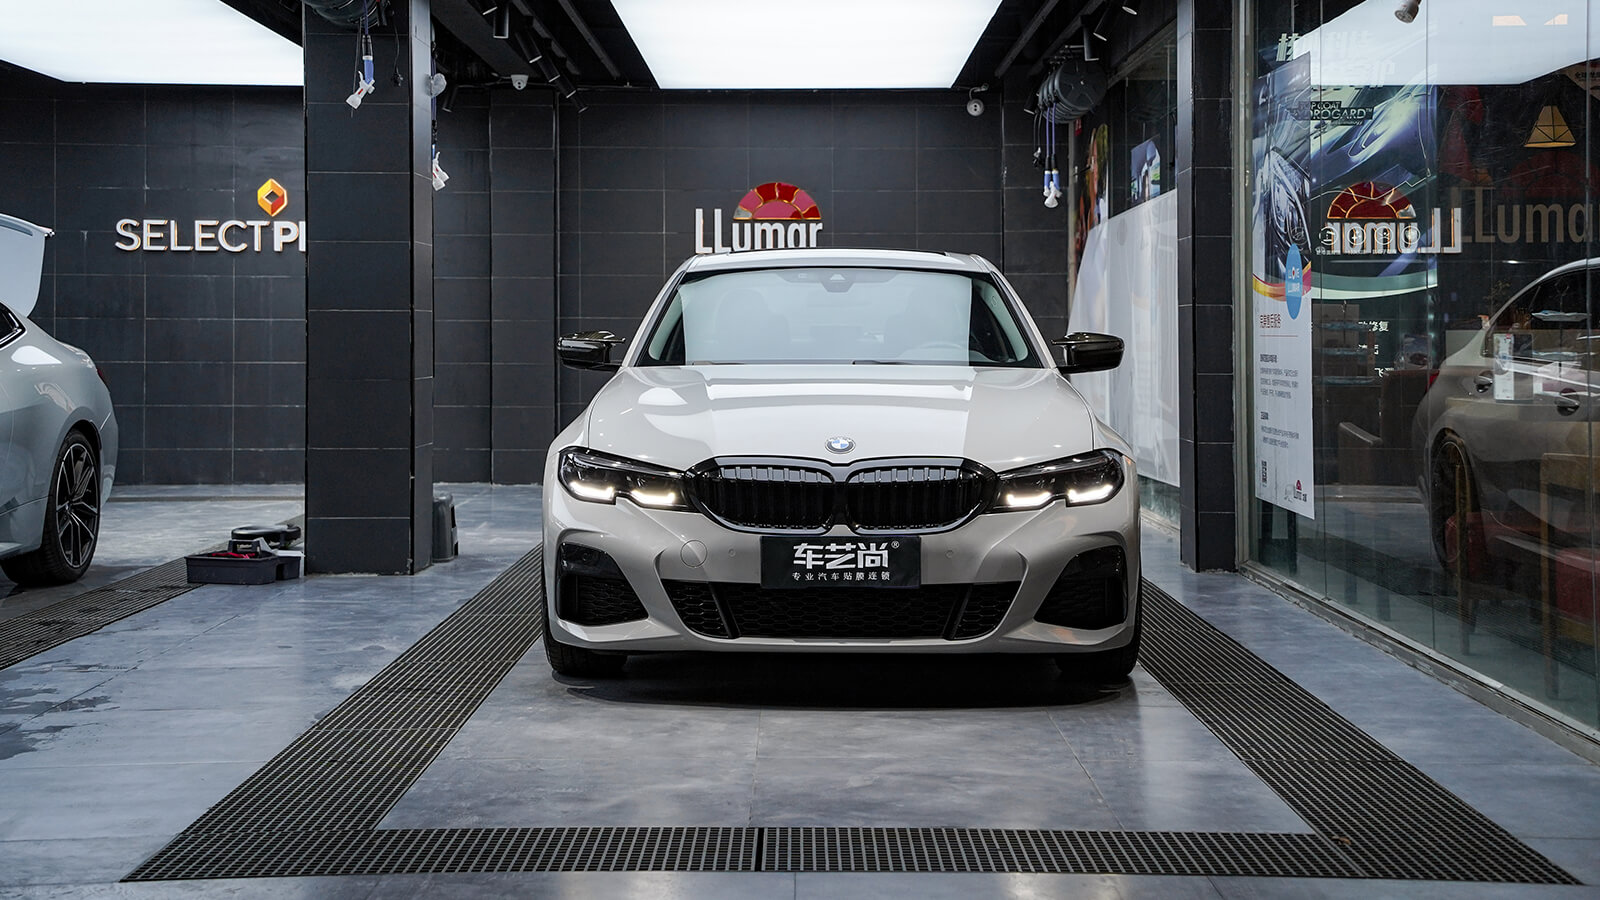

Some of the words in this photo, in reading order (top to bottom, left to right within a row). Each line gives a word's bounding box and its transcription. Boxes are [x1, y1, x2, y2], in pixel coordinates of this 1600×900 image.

[1317, 102, 1340, 110] COAT
[1451, 187, 1600, 243] LLuma
[695, 208, 823, 253] LLumar
[792, 571, 890, 581] 专业汽车贴膜连锁
